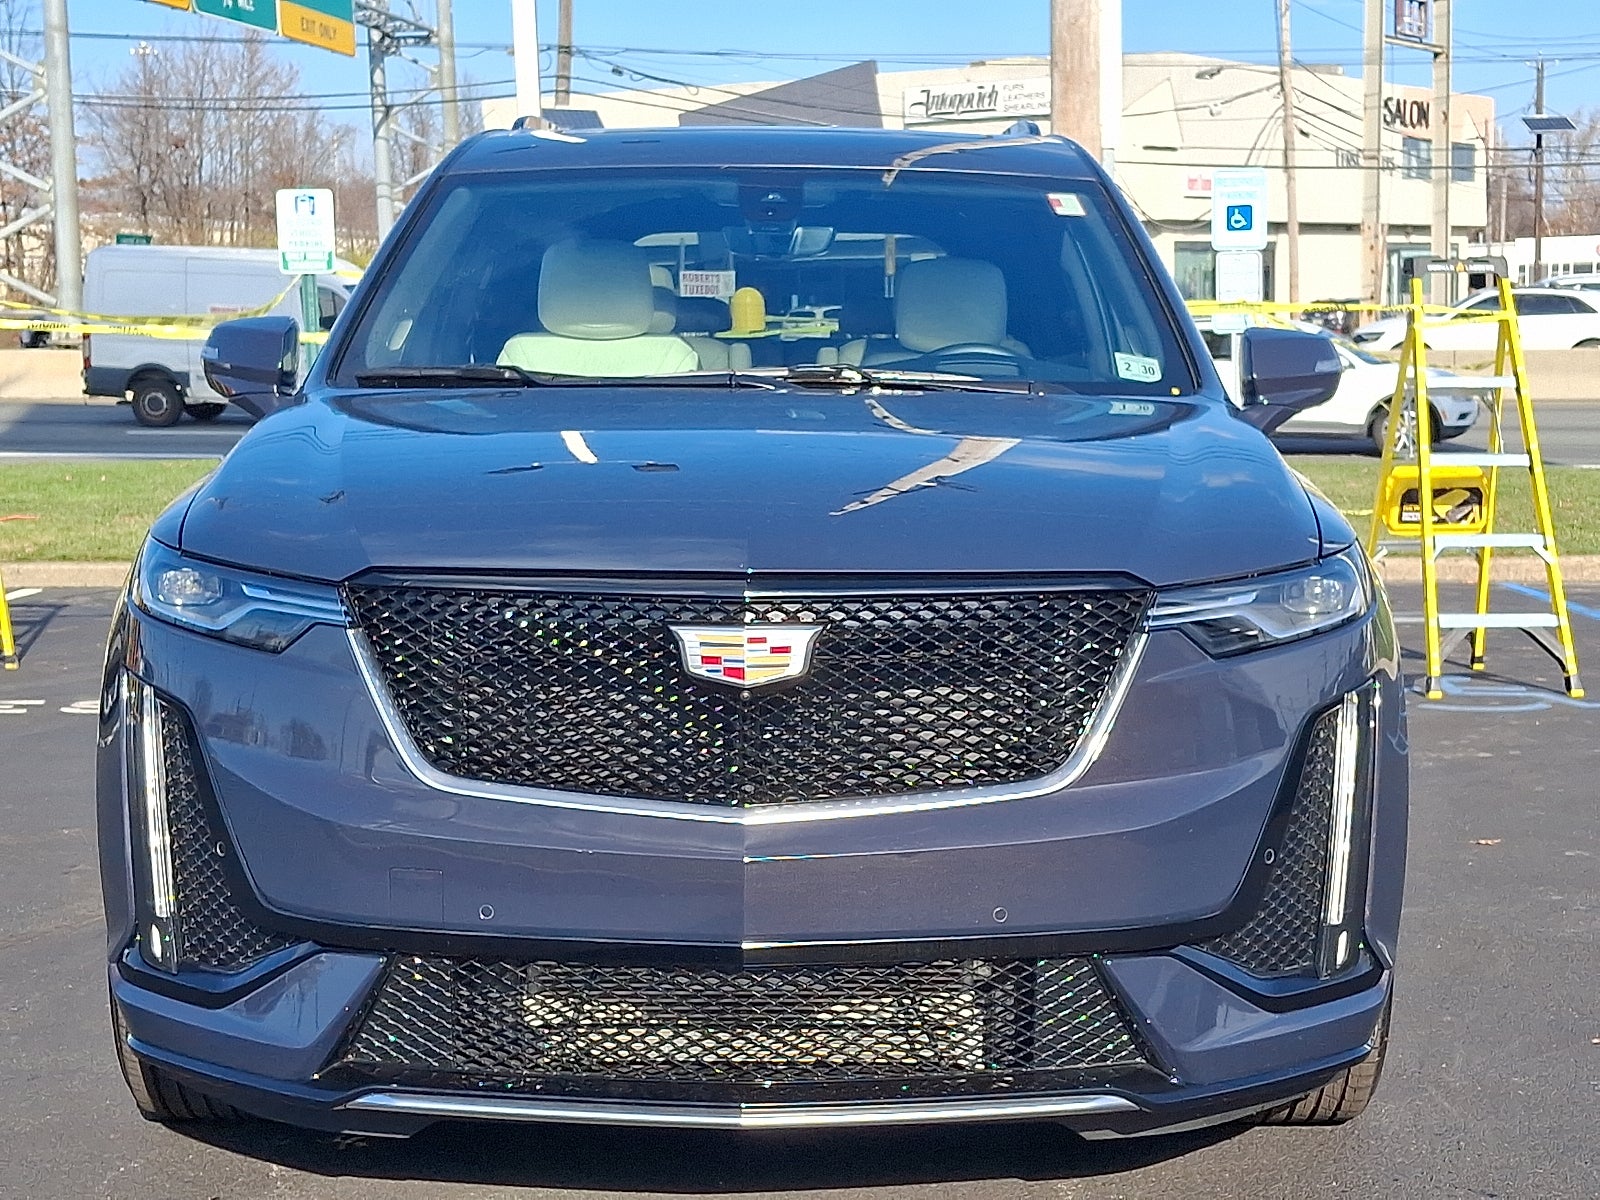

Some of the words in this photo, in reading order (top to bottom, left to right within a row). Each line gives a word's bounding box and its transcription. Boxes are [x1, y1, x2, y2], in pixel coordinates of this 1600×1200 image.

[301, 16, 316, 33] EXIT
[319, 22, 337, 40] ONLY
[1383, 96, 1430, 129] SALON
[682, 272, 720, 284] ROBERTS
[682, 284, 720, 295] TUXEDOS
[1124, 362, 1132, 372] 2
[1141, 365, 1155, 375] 30
